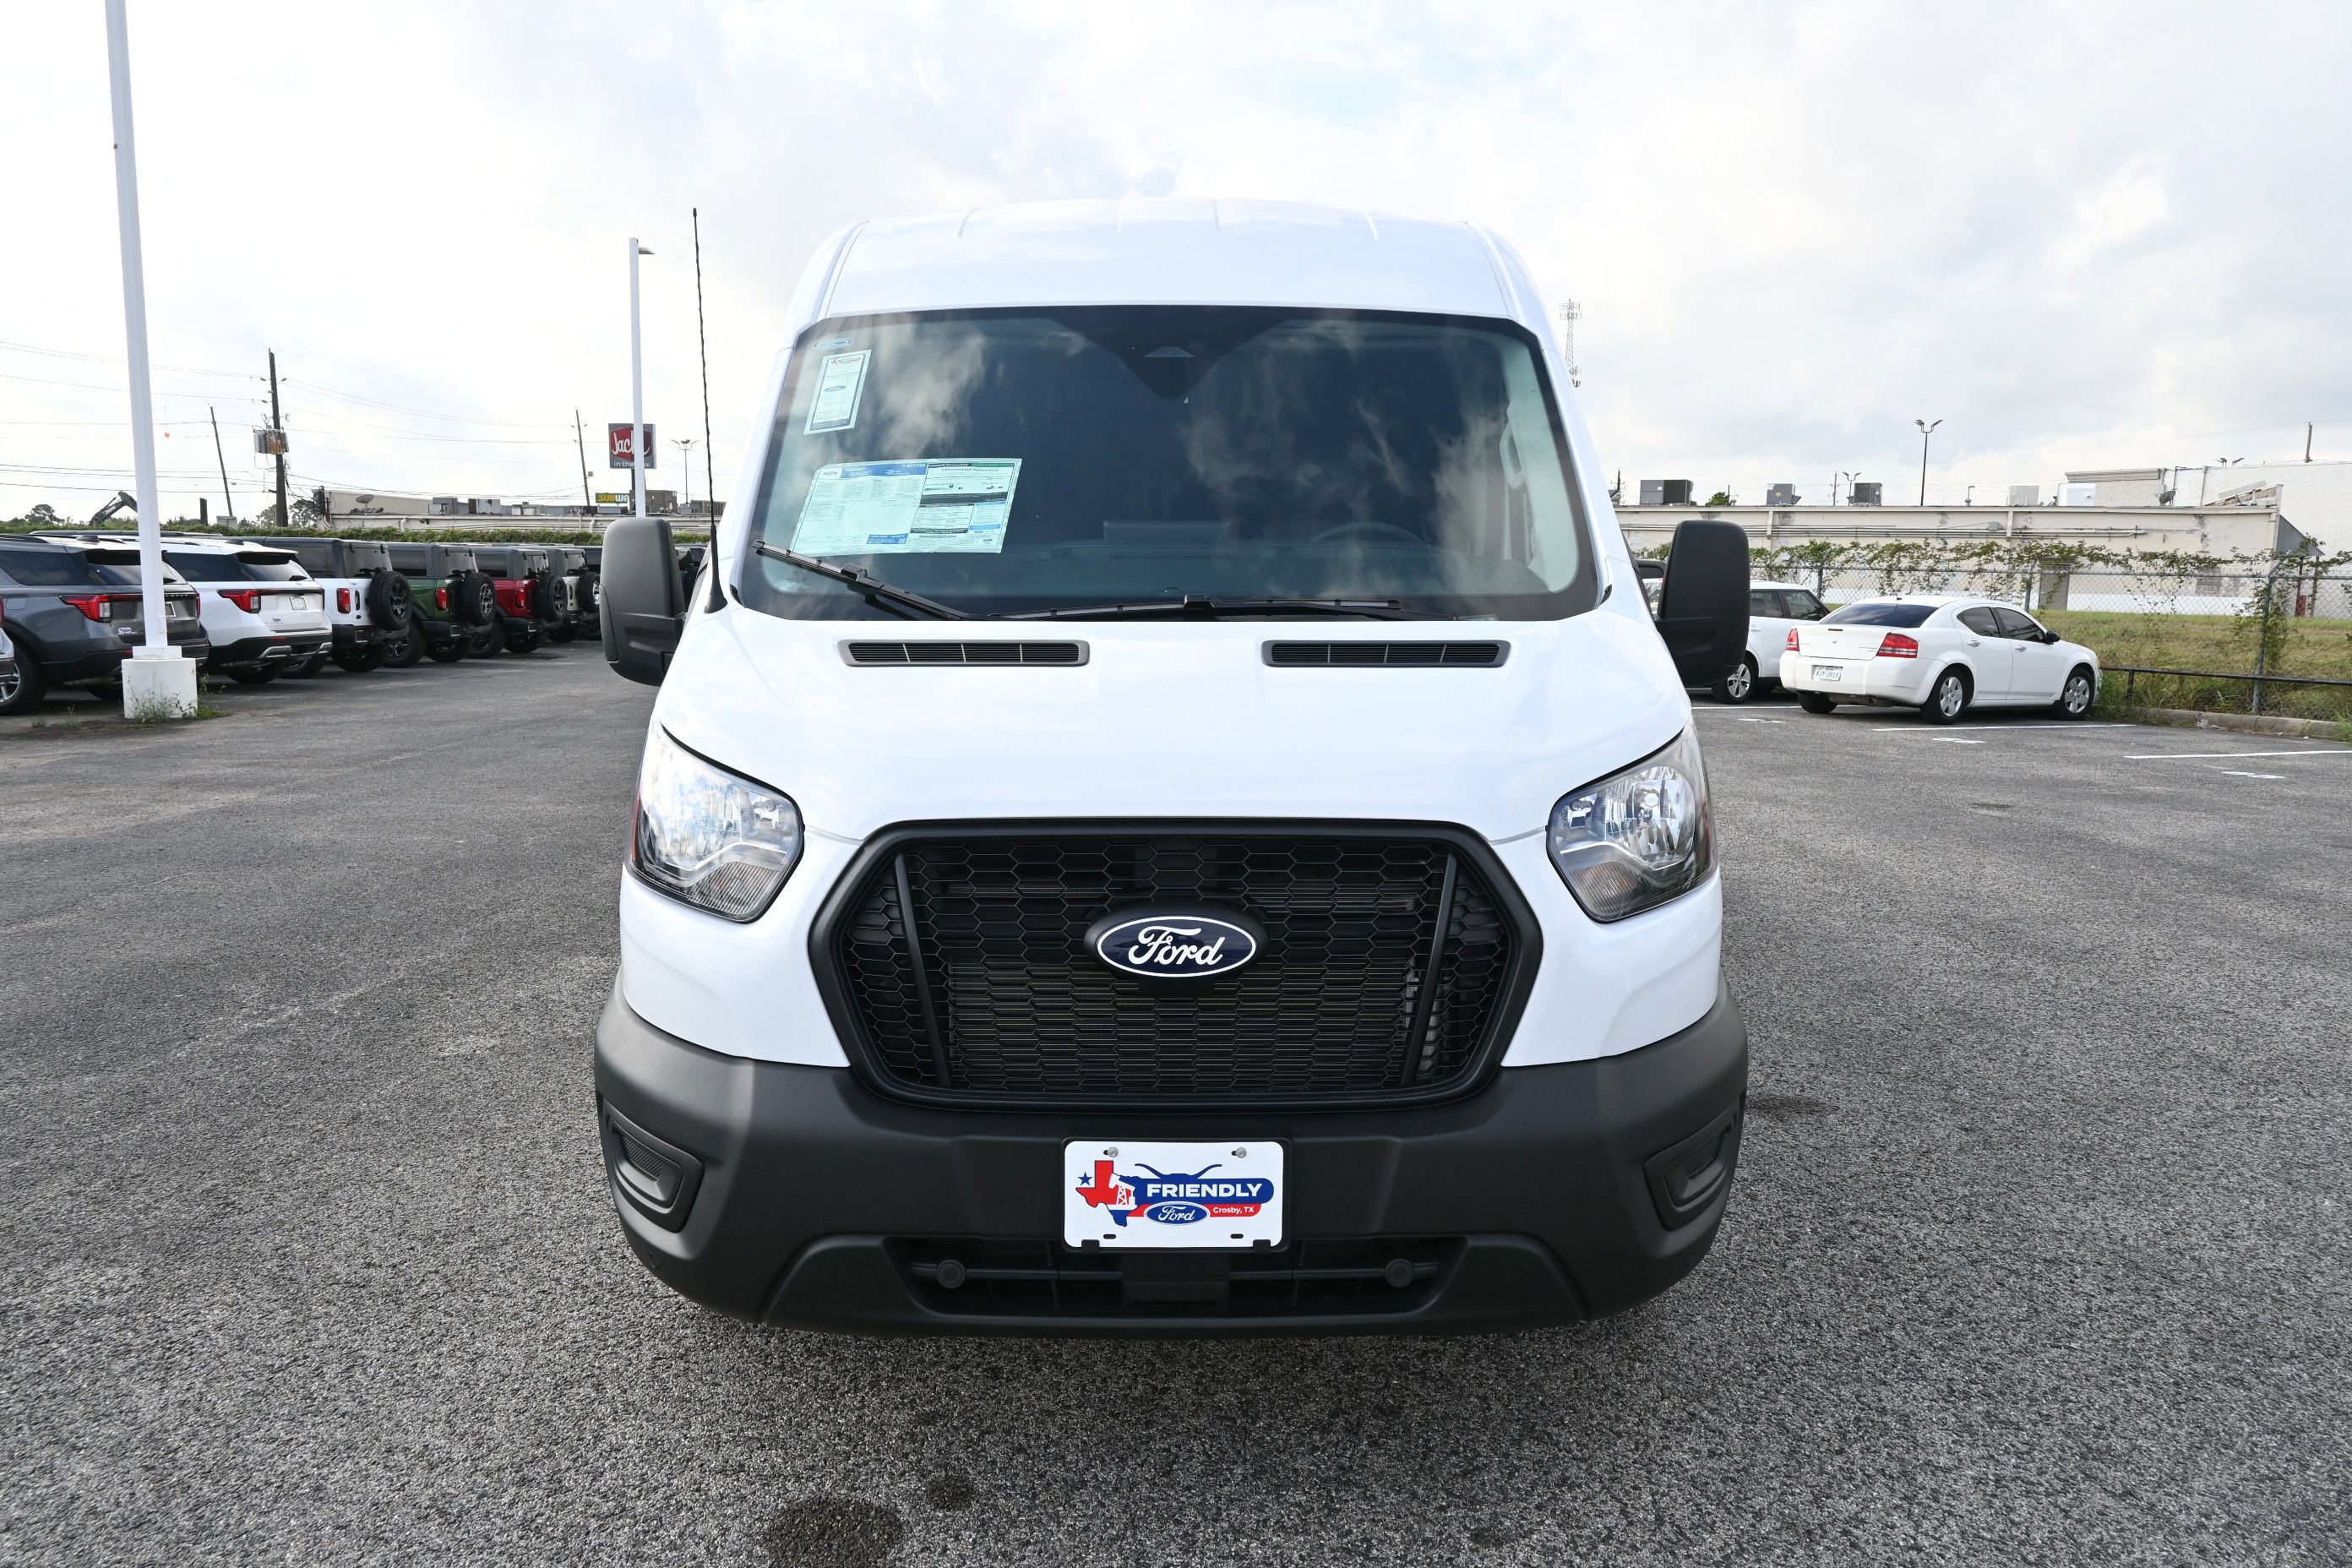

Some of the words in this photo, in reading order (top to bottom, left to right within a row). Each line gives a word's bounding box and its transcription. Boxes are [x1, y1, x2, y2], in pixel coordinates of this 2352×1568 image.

[1128, 925, 1226, 966] Ford
[1146, 1183, 1263, 1197] FRIENDLY
[1157, 1205, 1195, 1222] Ford
[1212, 1206, 1243, 1215] Crosby,
